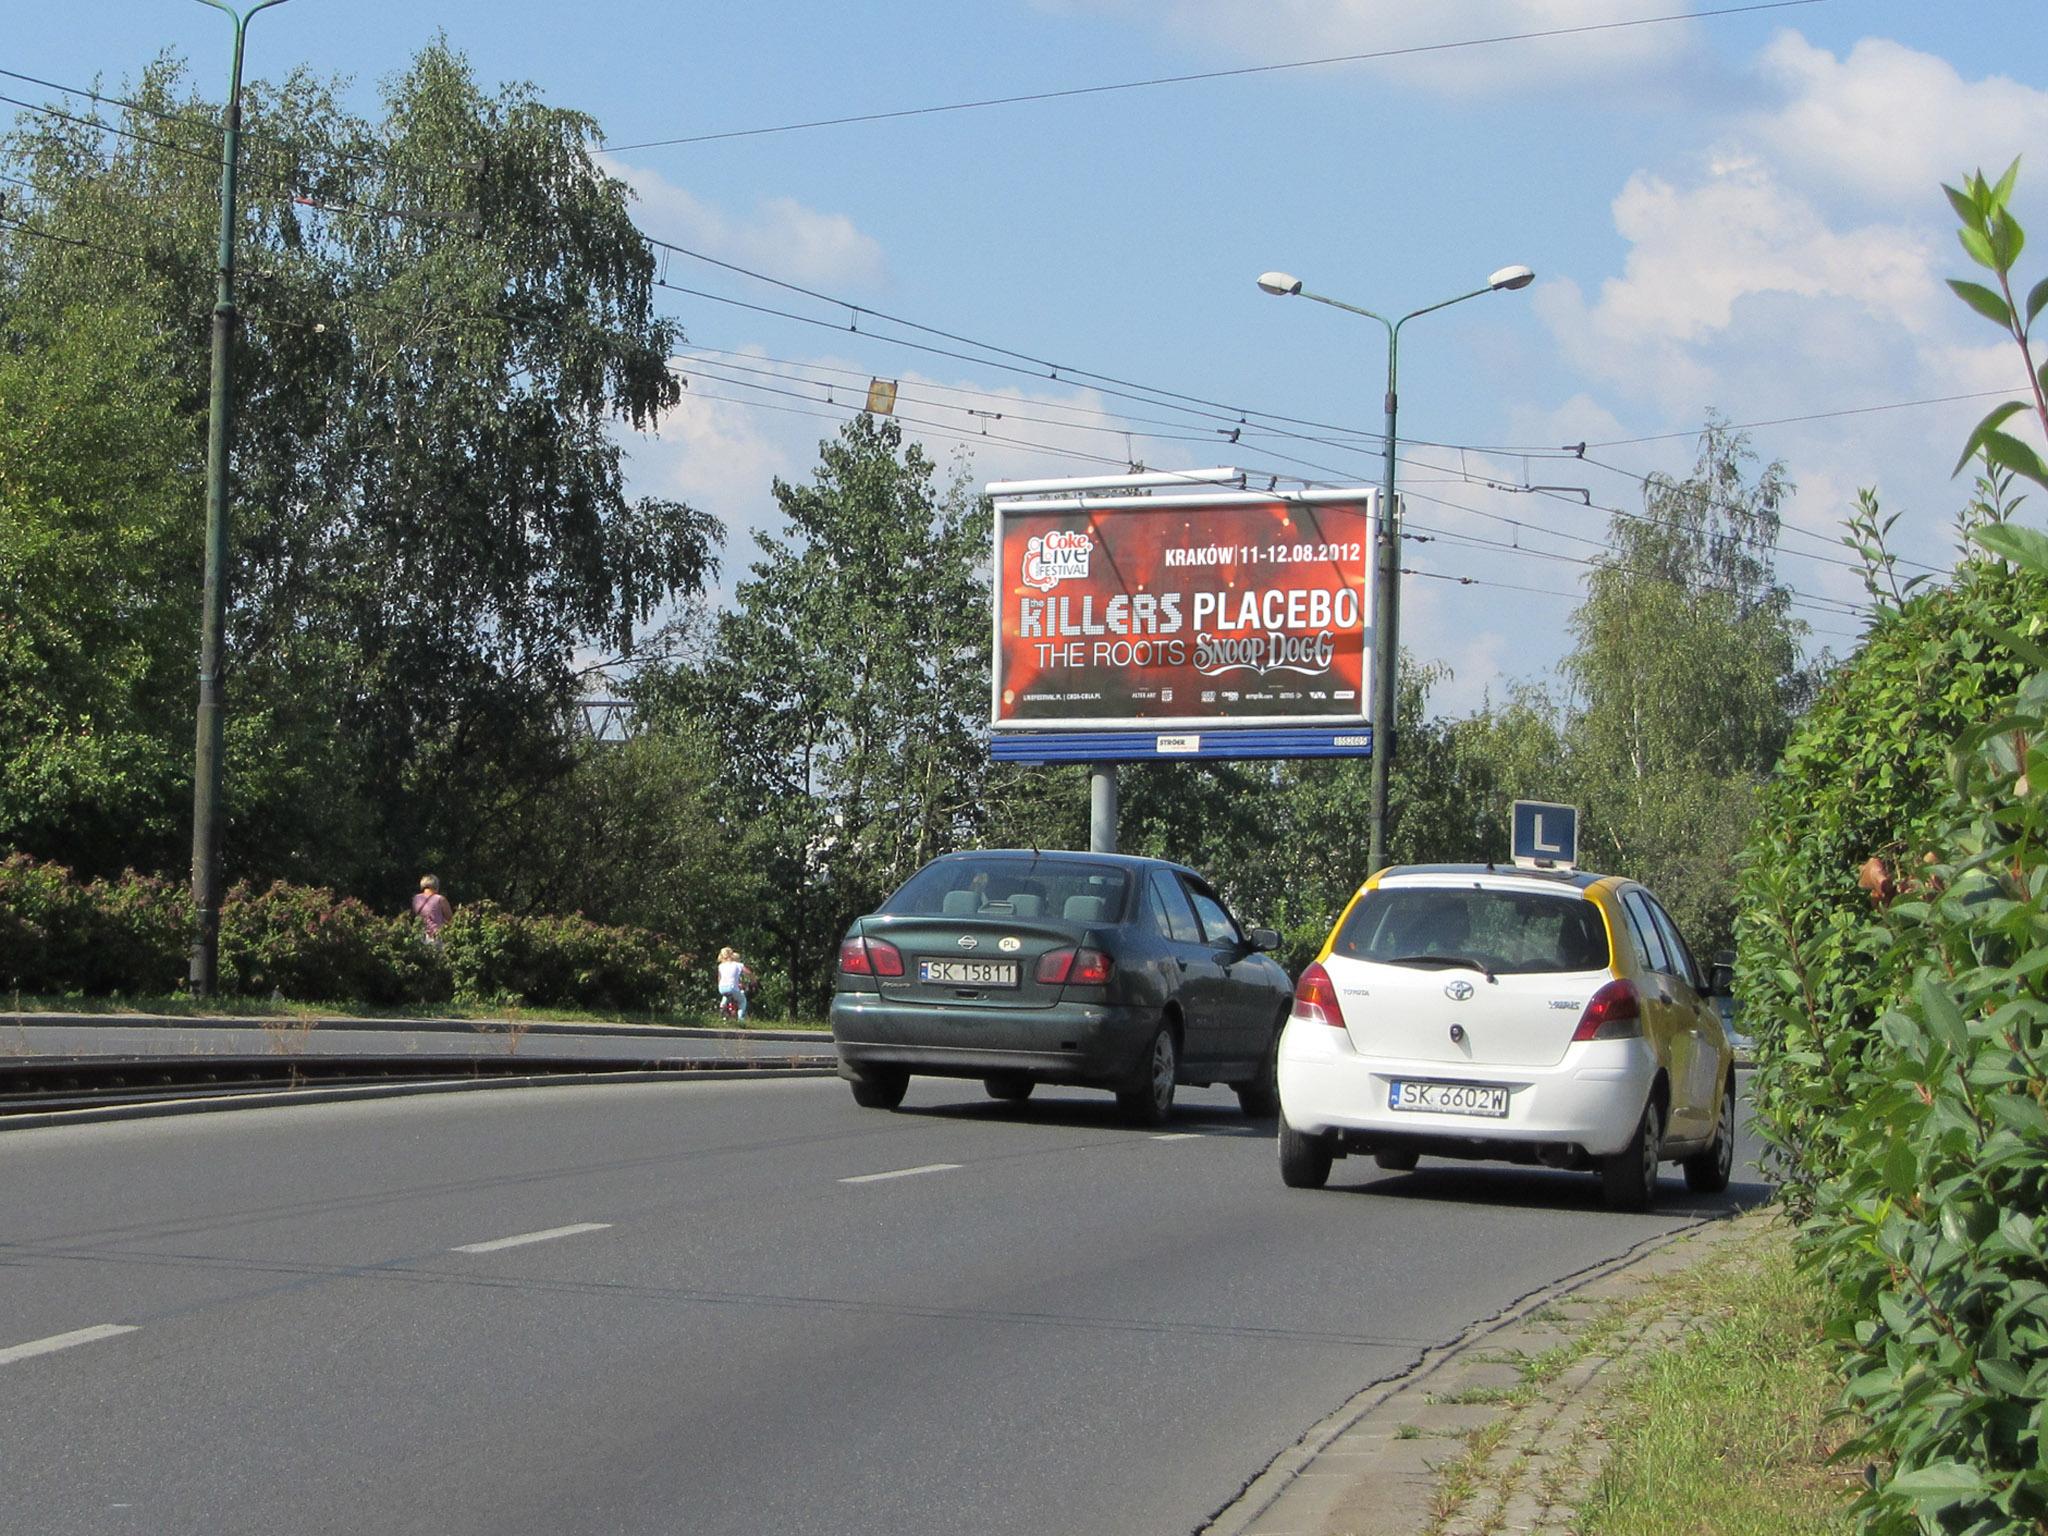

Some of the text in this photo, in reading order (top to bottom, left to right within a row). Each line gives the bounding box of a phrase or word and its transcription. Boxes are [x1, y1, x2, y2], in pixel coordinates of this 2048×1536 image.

[1046, 532, 1087, 550] Coke
[1165, 543, 1361, 567] KRAKÓW 11-12.08.2012
[1040, 564, 1087, 577] FESTIVAL
[1193, 588, 1359, 631] PLACEBO
[1034, 640, 1186, 668] THE ROOTS
[1534, 814, 1560, 853] L
[1003, 940, 1016, 949] PL
[931, 962, 1012, 982] SK 15811
[1404, 1084, 1432, 1105] SK
[1440, 1086, 1505, 1110] 6602W
